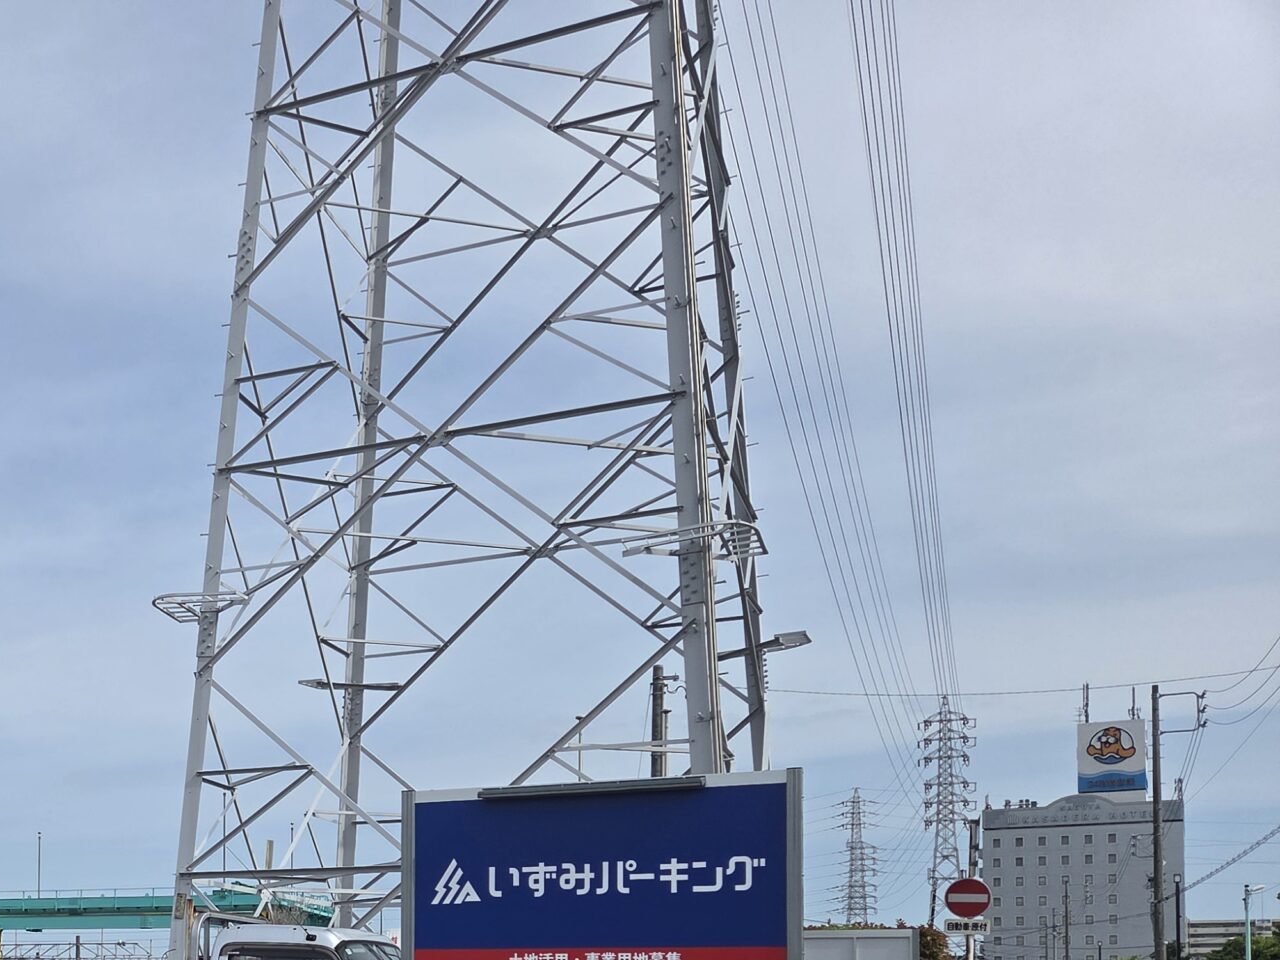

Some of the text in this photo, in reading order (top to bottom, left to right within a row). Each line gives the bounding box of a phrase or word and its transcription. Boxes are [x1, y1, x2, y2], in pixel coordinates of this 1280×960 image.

[487, 855, 766, 897] いずみパーキング
